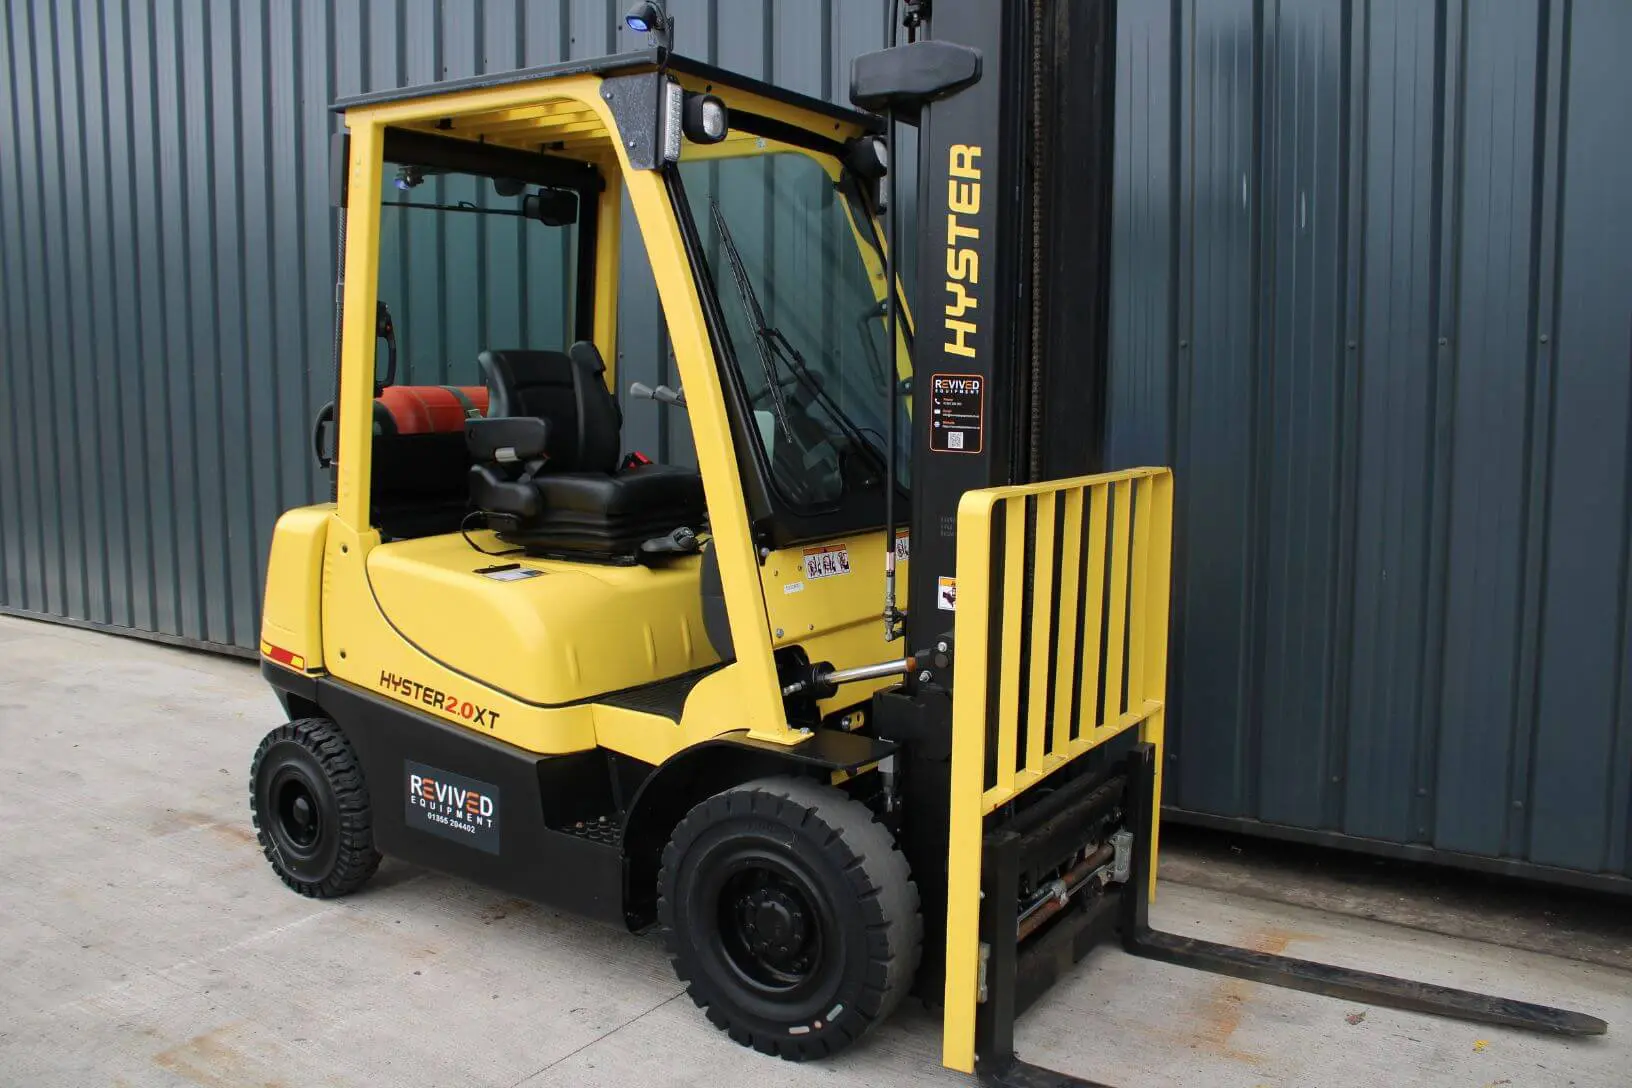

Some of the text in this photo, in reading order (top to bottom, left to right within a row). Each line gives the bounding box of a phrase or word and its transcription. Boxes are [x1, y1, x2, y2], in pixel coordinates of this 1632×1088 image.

[944, 144, 981, 358] HYSTER
[935, 380, 979, 390] REVIVED
[410, 774, 493, 817] REVIVED
[411, 796, 493, 828] EQUIPMENT
